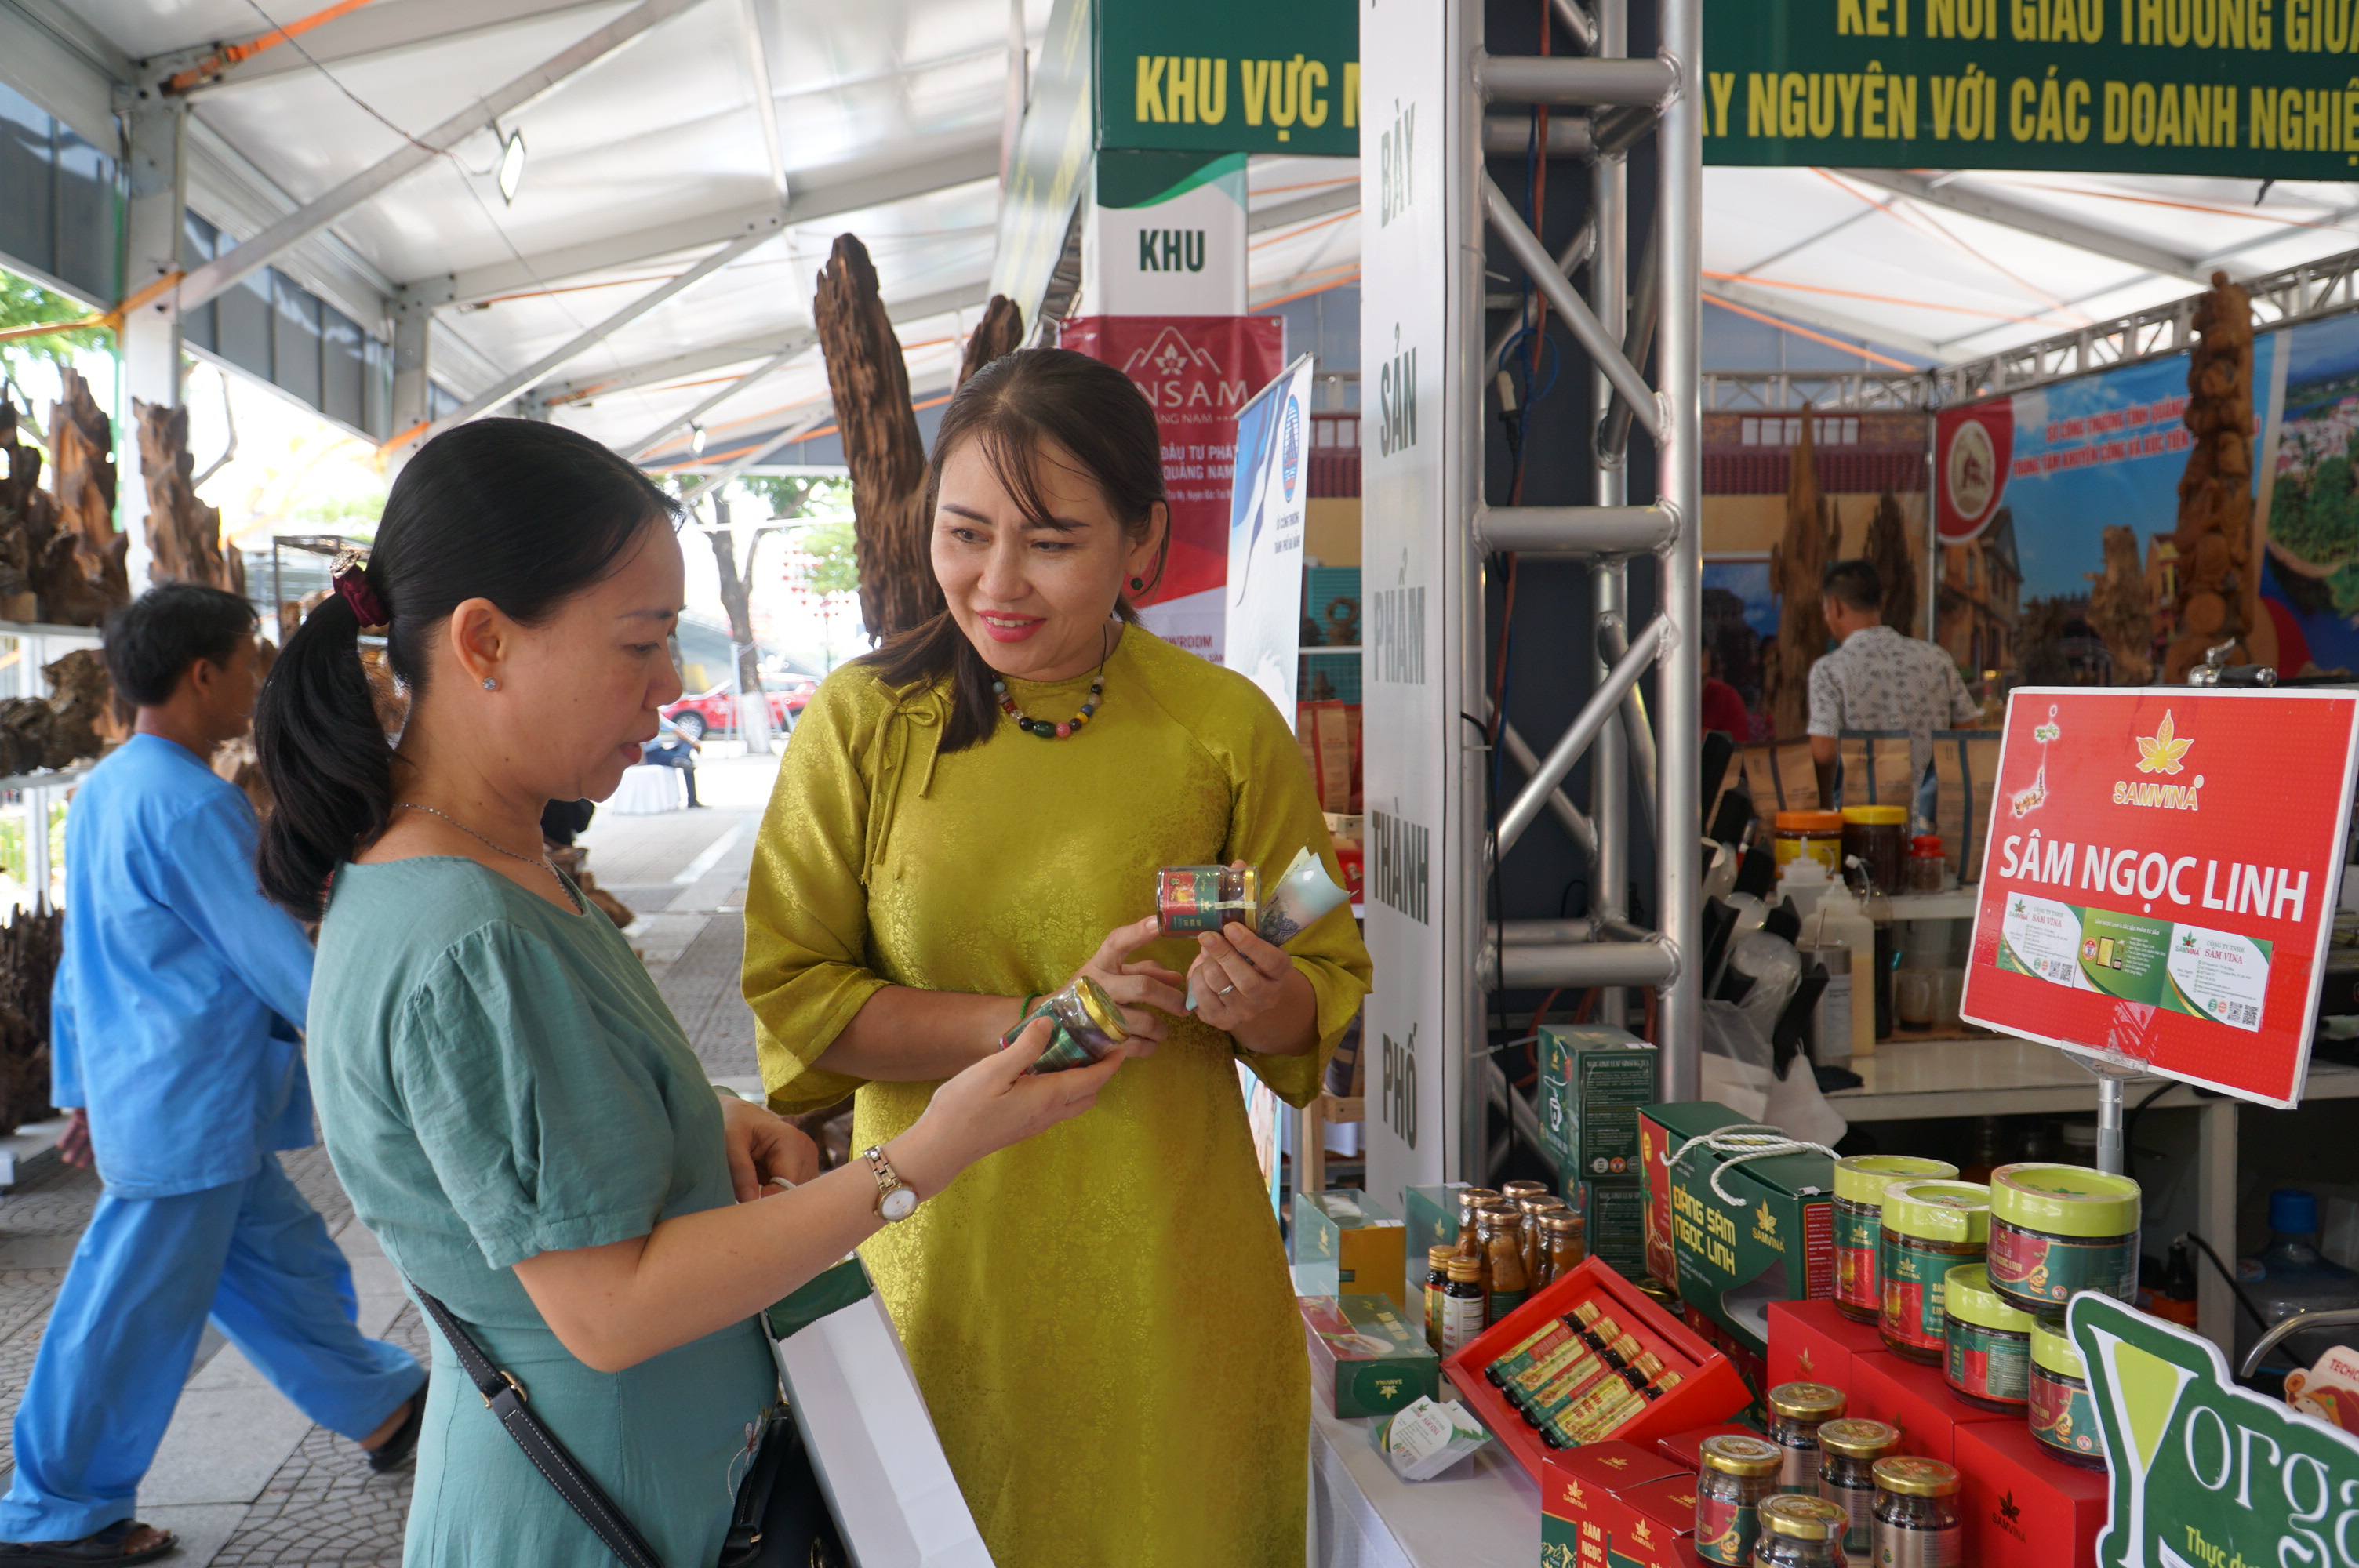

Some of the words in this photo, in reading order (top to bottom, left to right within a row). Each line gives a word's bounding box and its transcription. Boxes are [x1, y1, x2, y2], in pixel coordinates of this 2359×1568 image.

[1136, 55, 1227, 125] KHU
[1241, 53, 1329, 142] VỰC
[1702, 71, 1736, 138] Y
[1747, 59, 1917, 140] NGUYÊN
[1930, 62, 1997, 141] VỚI
[2010, 64, 2091, 143] CÁC
[2103, 80, 2237, 148] DOANH
[1381, 97, 1416, 229] BÀY
[1140, 229, 1205, 272] KHU
[1380, 321, 1416, 458] SẢN
[1182, 413, 1213, 424] NAM
[2113, 780, 2199, 811] SAMVINA
[1372, 796, 1429, 927] THÀNH
[1999, 828, 2076, 887] SÂM
[2081, 844, 2197, 913] NGỌC
[2202, 859, 2309, 922] LINH
[2175, 945, 2200, 956] SAMVINA
[2223, 952, 2243, 964] VINA
[1383, 1022, 1417, 1151] PHỐ
[1674, 1183, 1703, 1225] ĐẢNG
[1707, 1207, 1736, 1247] SÂM
[1675, 1214, 1704, 1254] NGỌC
[1707, 1236, 1736, 1276] LINH
[1752, 1227, 1786, 1253] SAMVINA
[1896, 1269, 1921, 1279] SAMVINA
[1563, 1494, 1587, 1510] SAMVINA
[1583, 1521, 1601, 1542] SÂM
[1631, 1533, 1656, 1552] SAMVINA
[1992, 1512, 2027, 1544] SAMVINA
[2185, 1524, 2227, 1568] Thực
[1582, 1540, 1601, 1563] NGỌC
